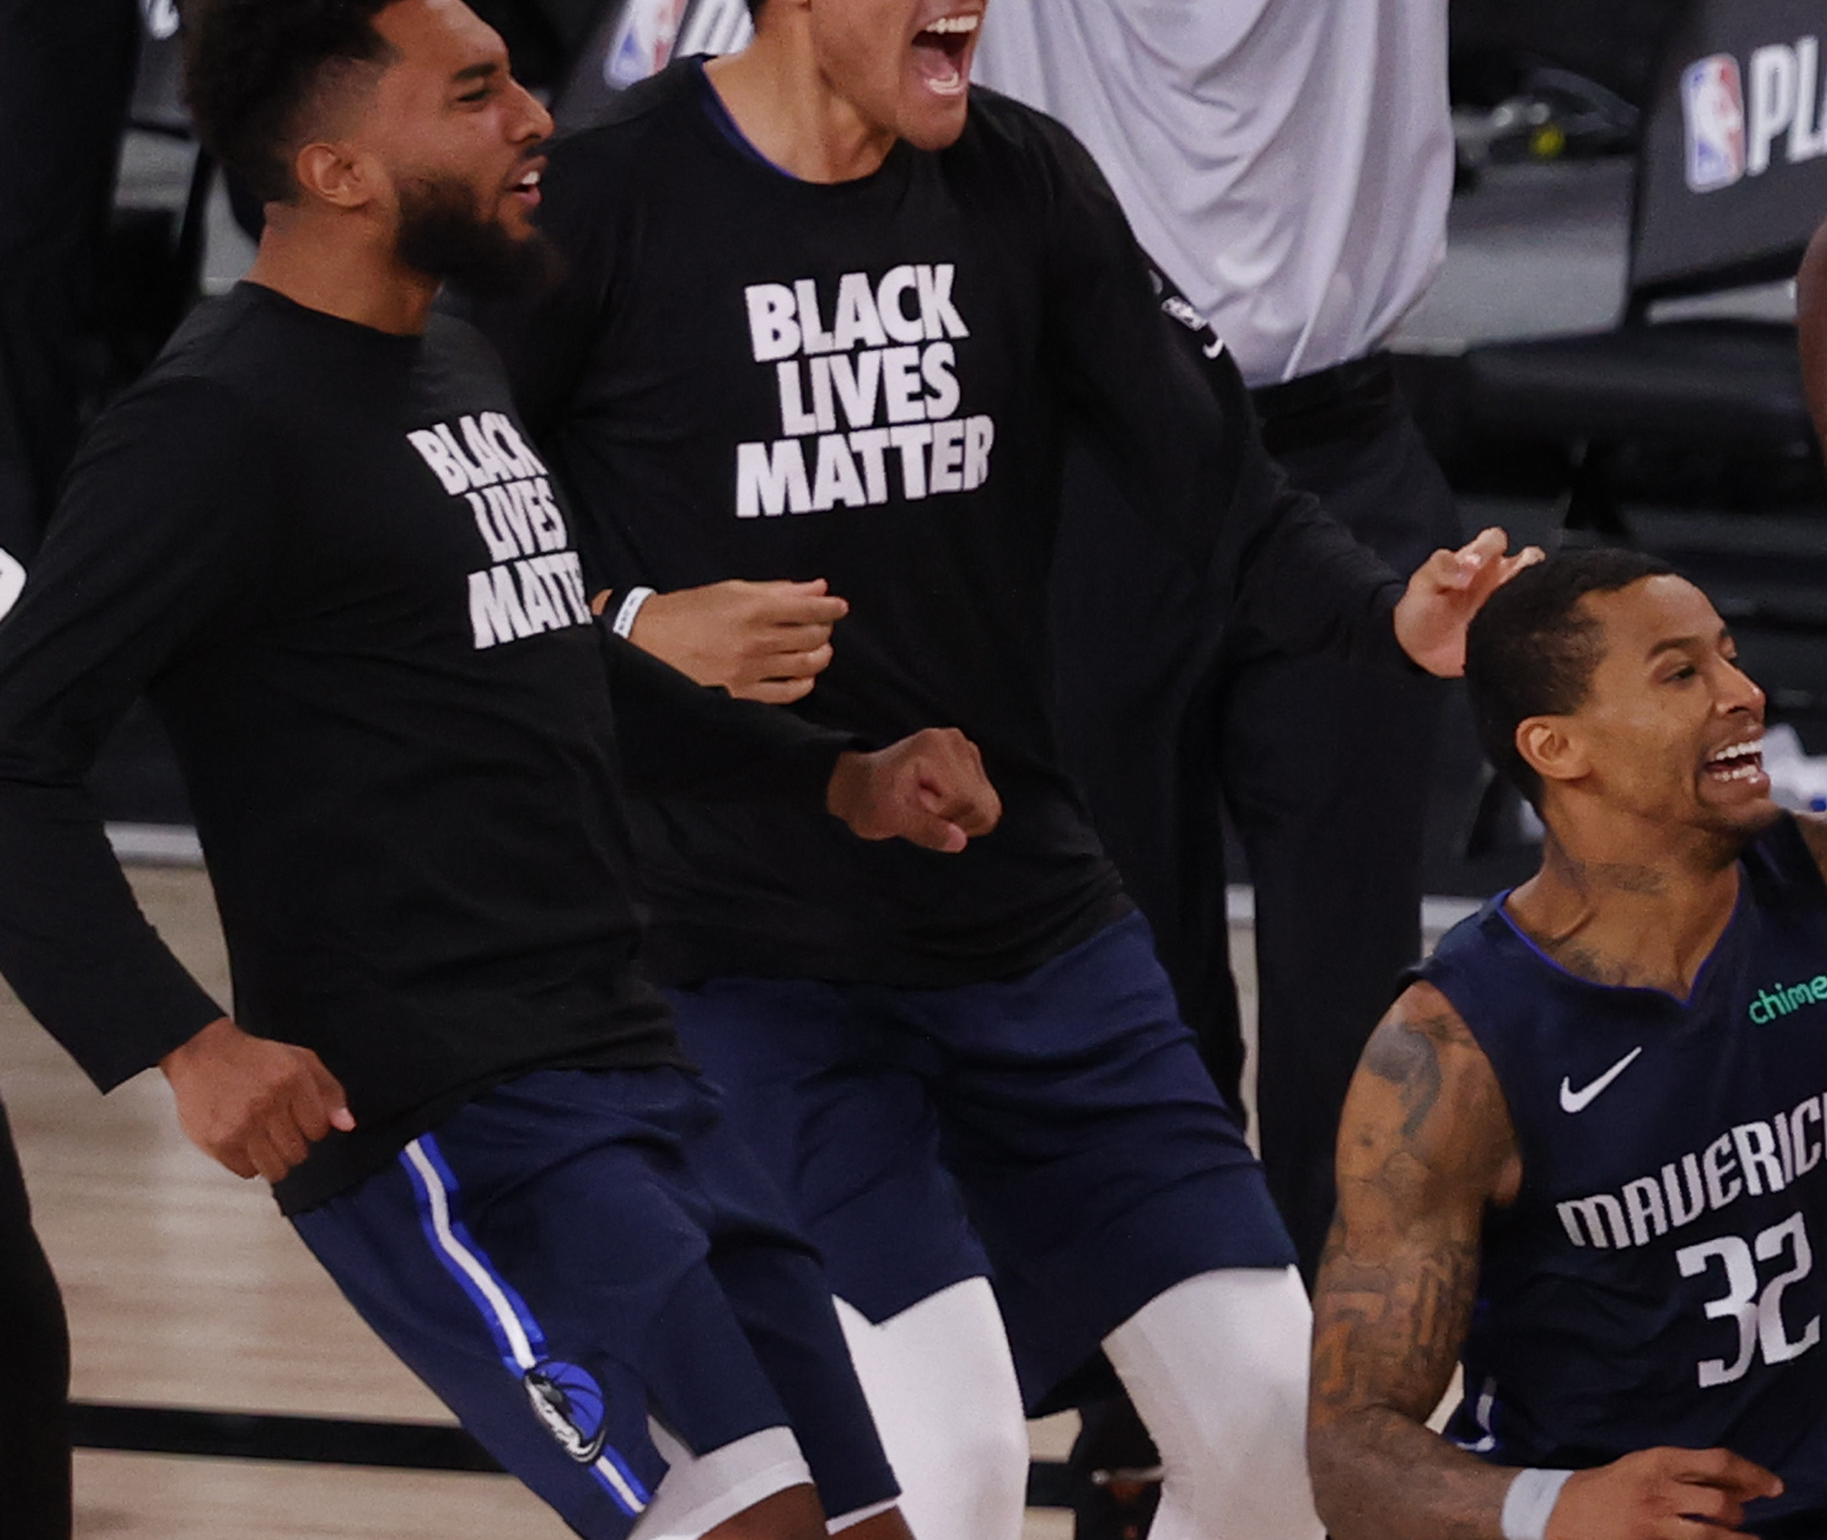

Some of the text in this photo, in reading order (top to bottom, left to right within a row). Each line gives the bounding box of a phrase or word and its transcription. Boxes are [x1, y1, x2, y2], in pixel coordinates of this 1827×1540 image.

[745, 263, 970, 362] BLACK
[776, 341, 961, 436] LIVES
[405, 411, 549, 495] BLACK
[736, 415, 994, 518] MATTER
[464, 477, 568, 562] LIVES
[1677, 1211, 1821, 1388] 32
